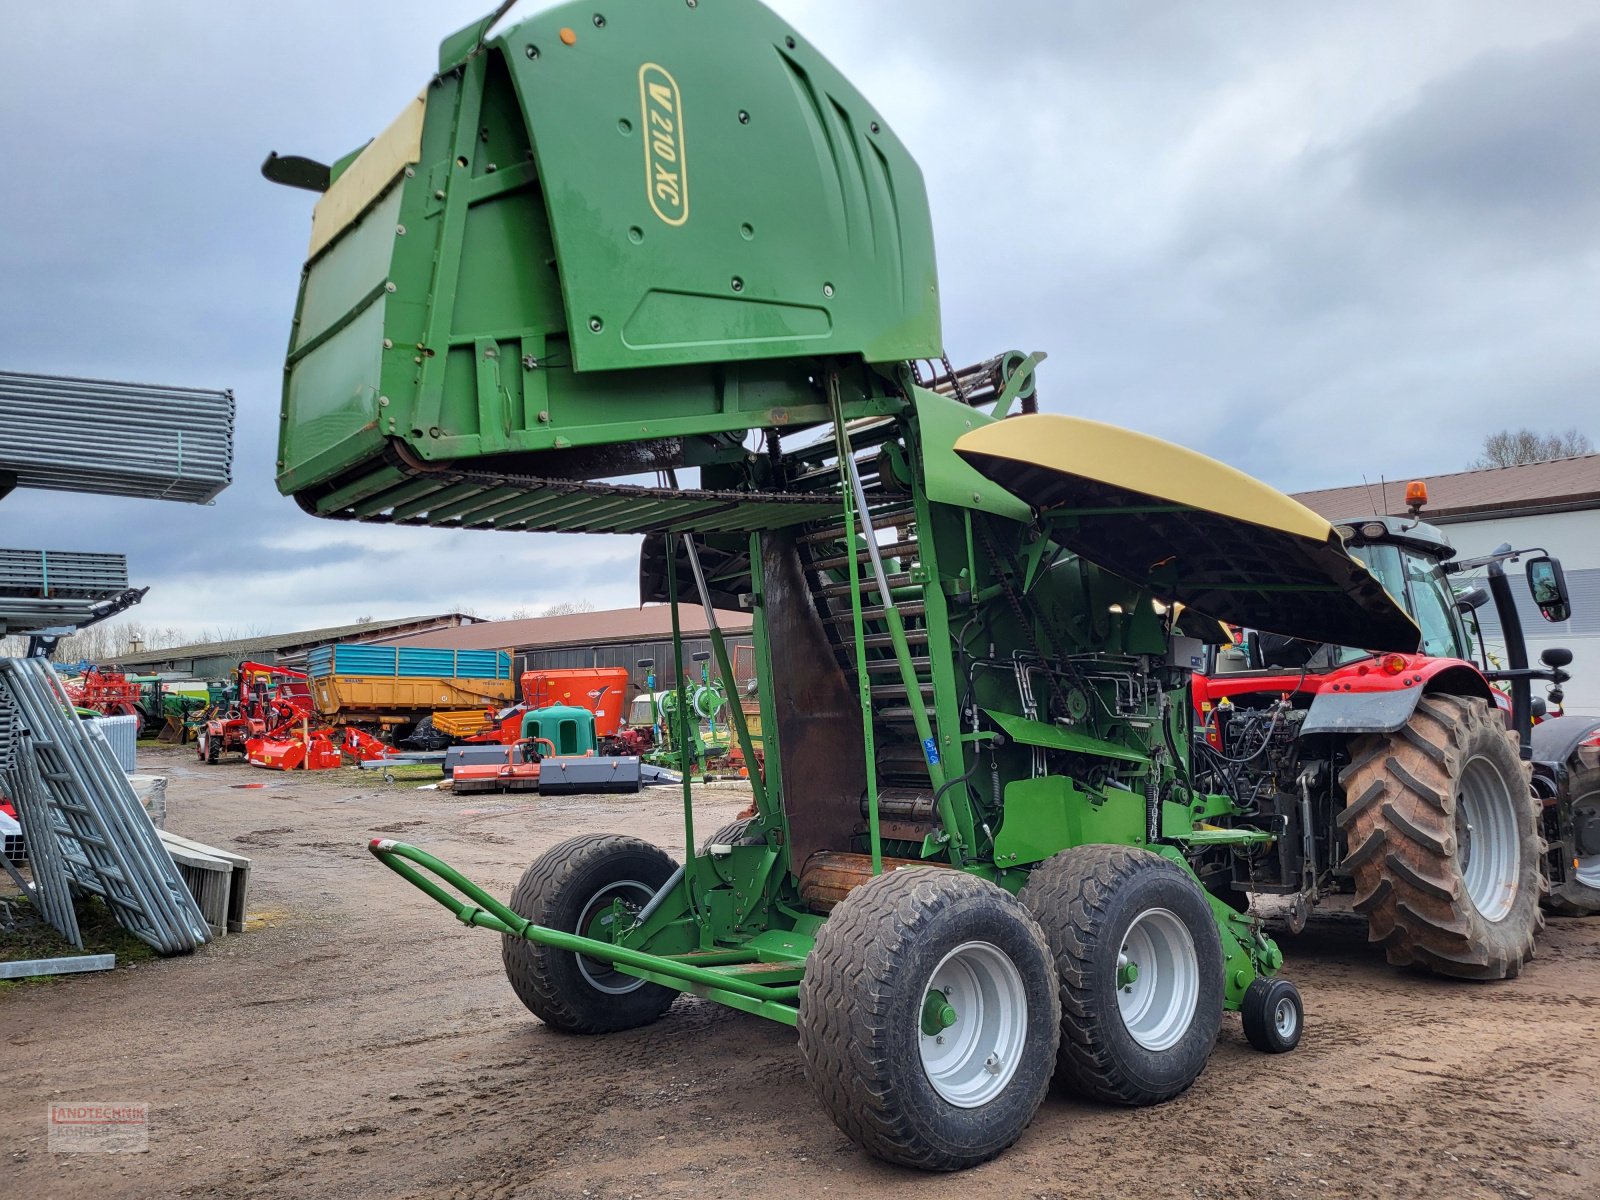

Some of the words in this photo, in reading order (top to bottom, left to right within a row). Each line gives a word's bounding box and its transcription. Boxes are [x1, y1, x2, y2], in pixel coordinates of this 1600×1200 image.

[648, 82, 673, 114] V
[651, 109, 676, 163] 210
[655, 162, 680, 207] XC
